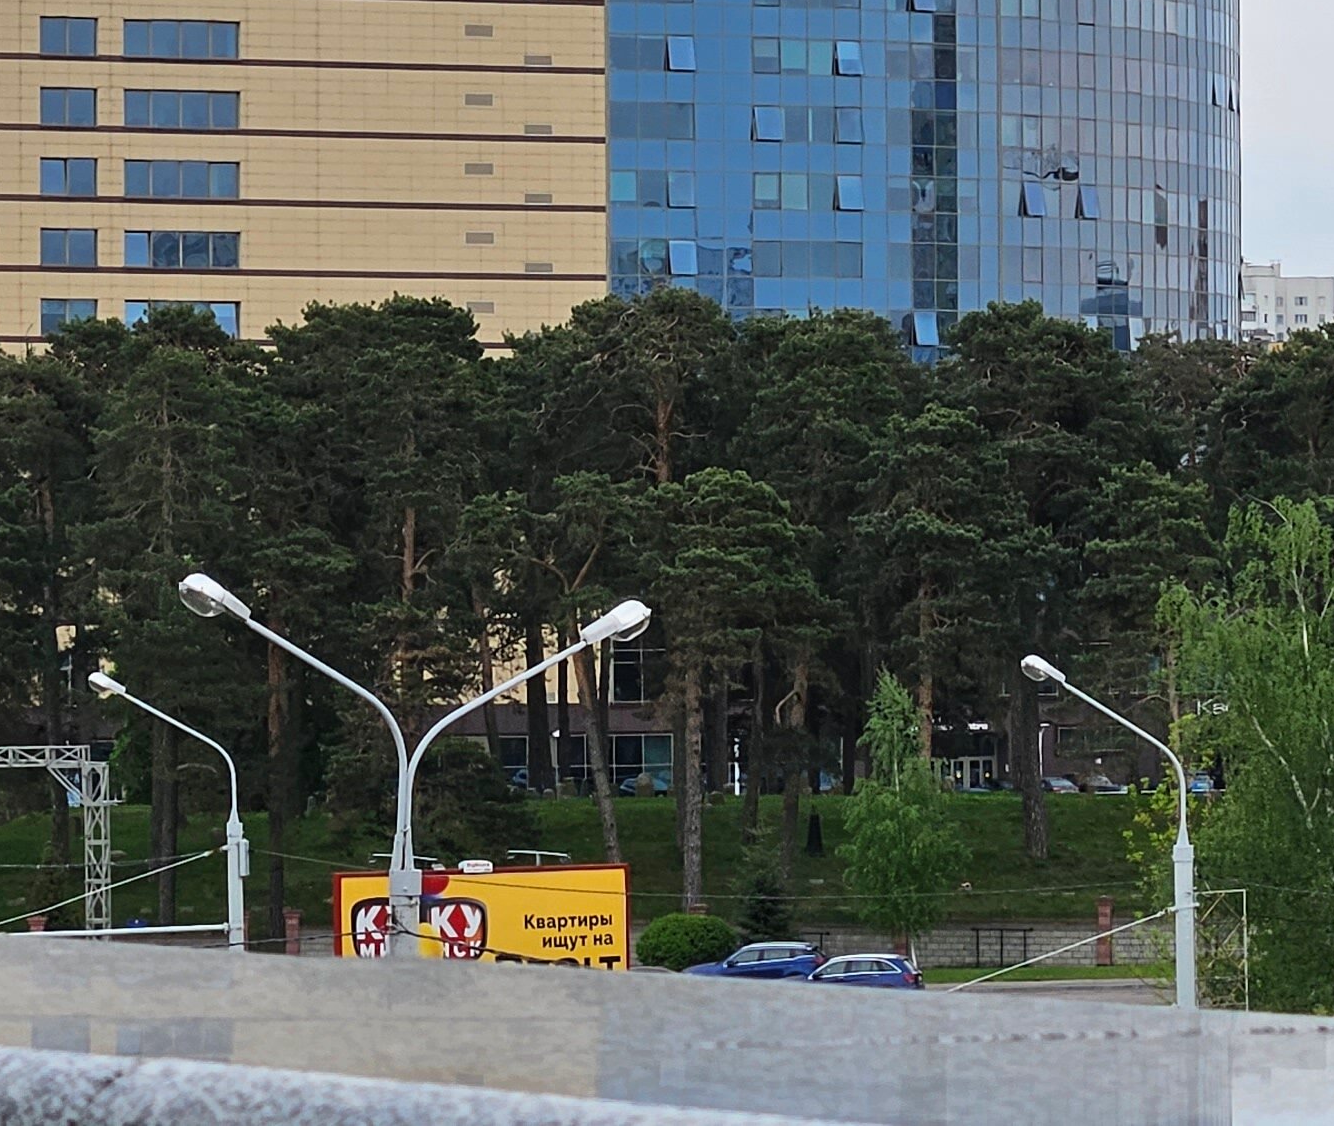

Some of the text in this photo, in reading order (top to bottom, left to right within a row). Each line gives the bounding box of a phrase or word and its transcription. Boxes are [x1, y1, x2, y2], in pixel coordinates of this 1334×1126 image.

[524, 914, 613, 932] Квартиры
[542, 933, 614, 951] ищут на
